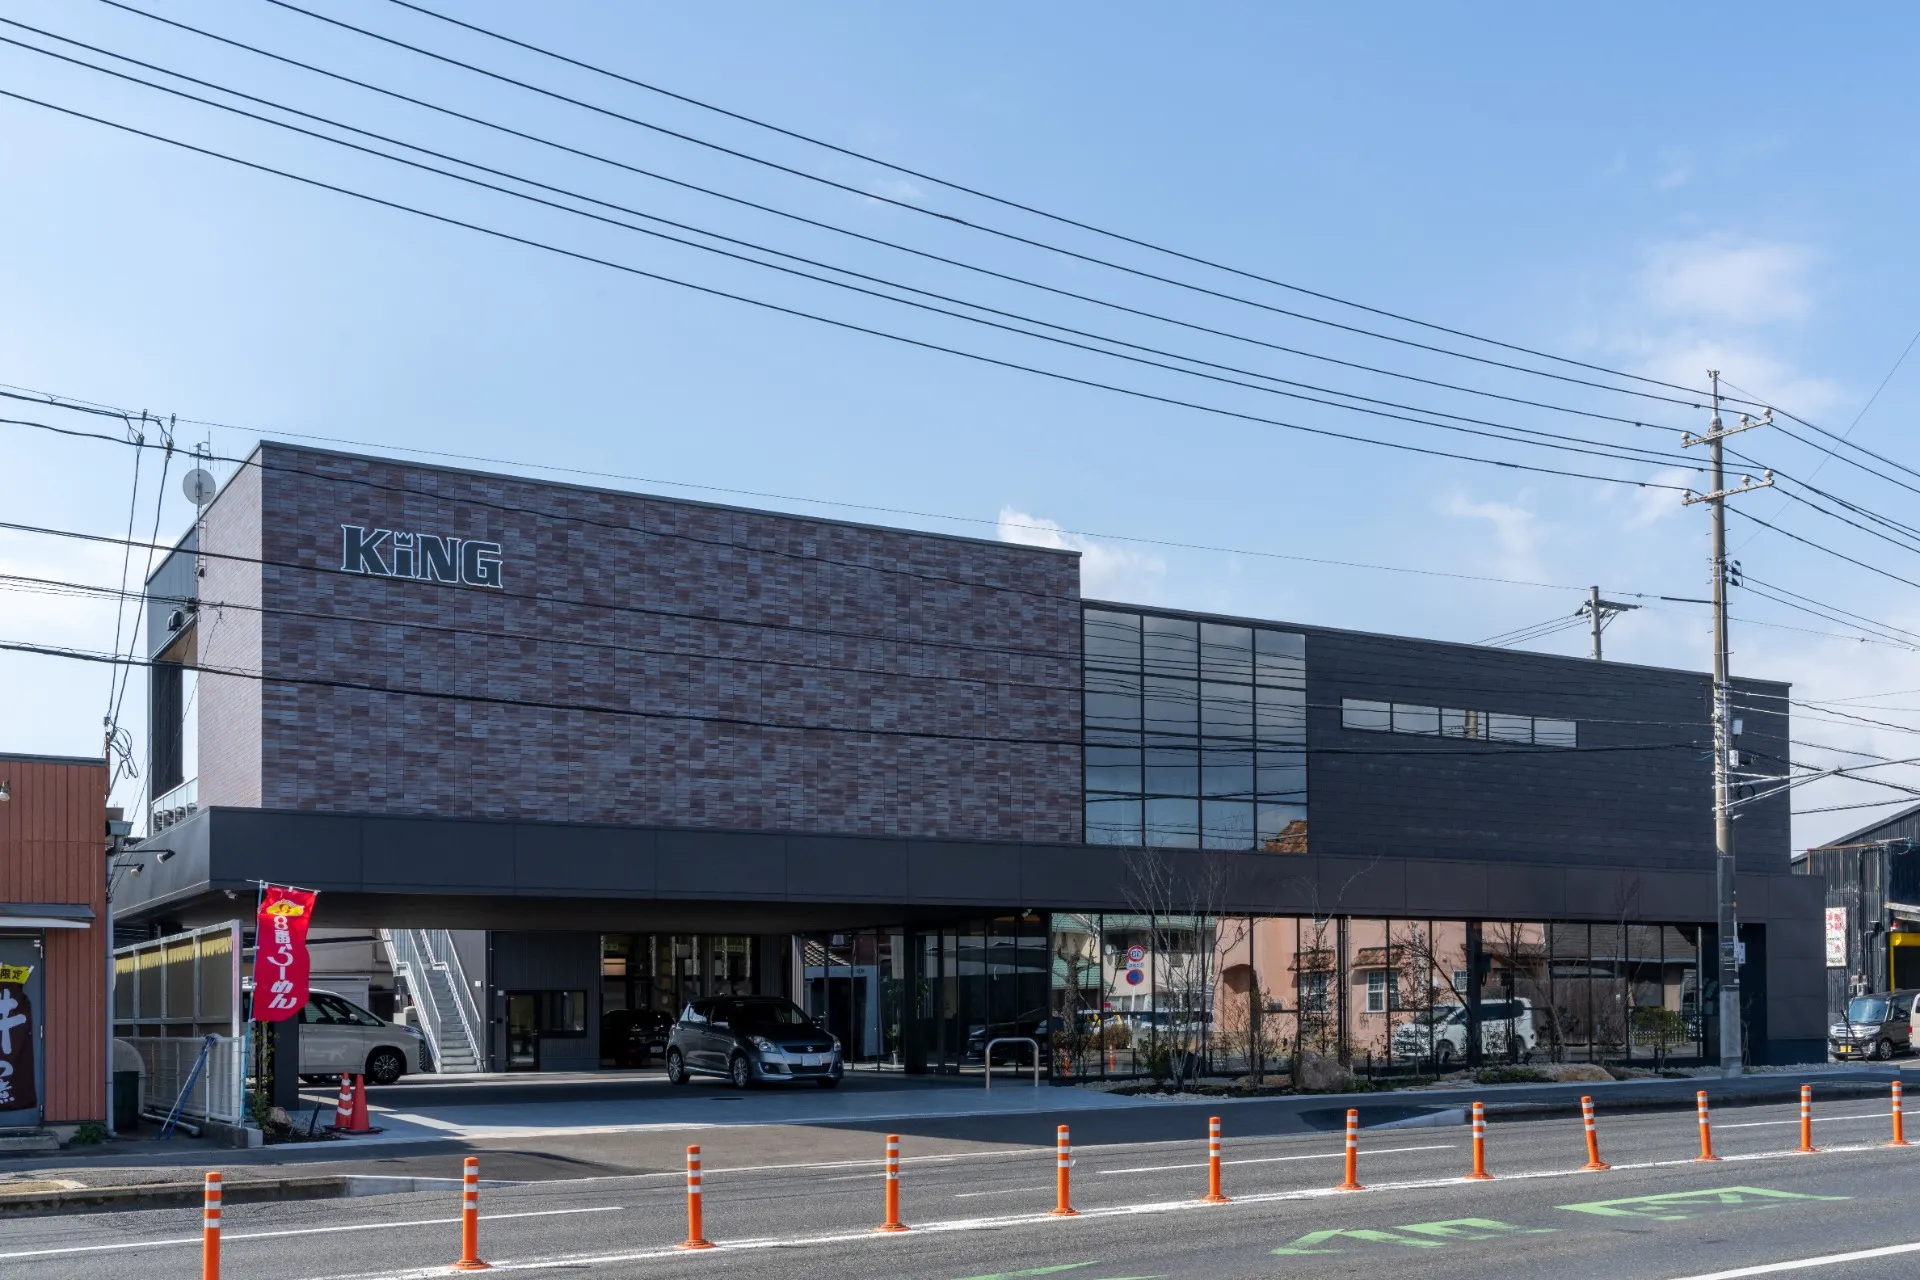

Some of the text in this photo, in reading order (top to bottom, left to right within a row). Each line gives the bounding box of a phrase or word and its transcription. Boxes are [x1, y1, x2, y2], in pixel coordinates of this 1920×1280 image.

[266, 915, 298, 1009] 8番らーめん
